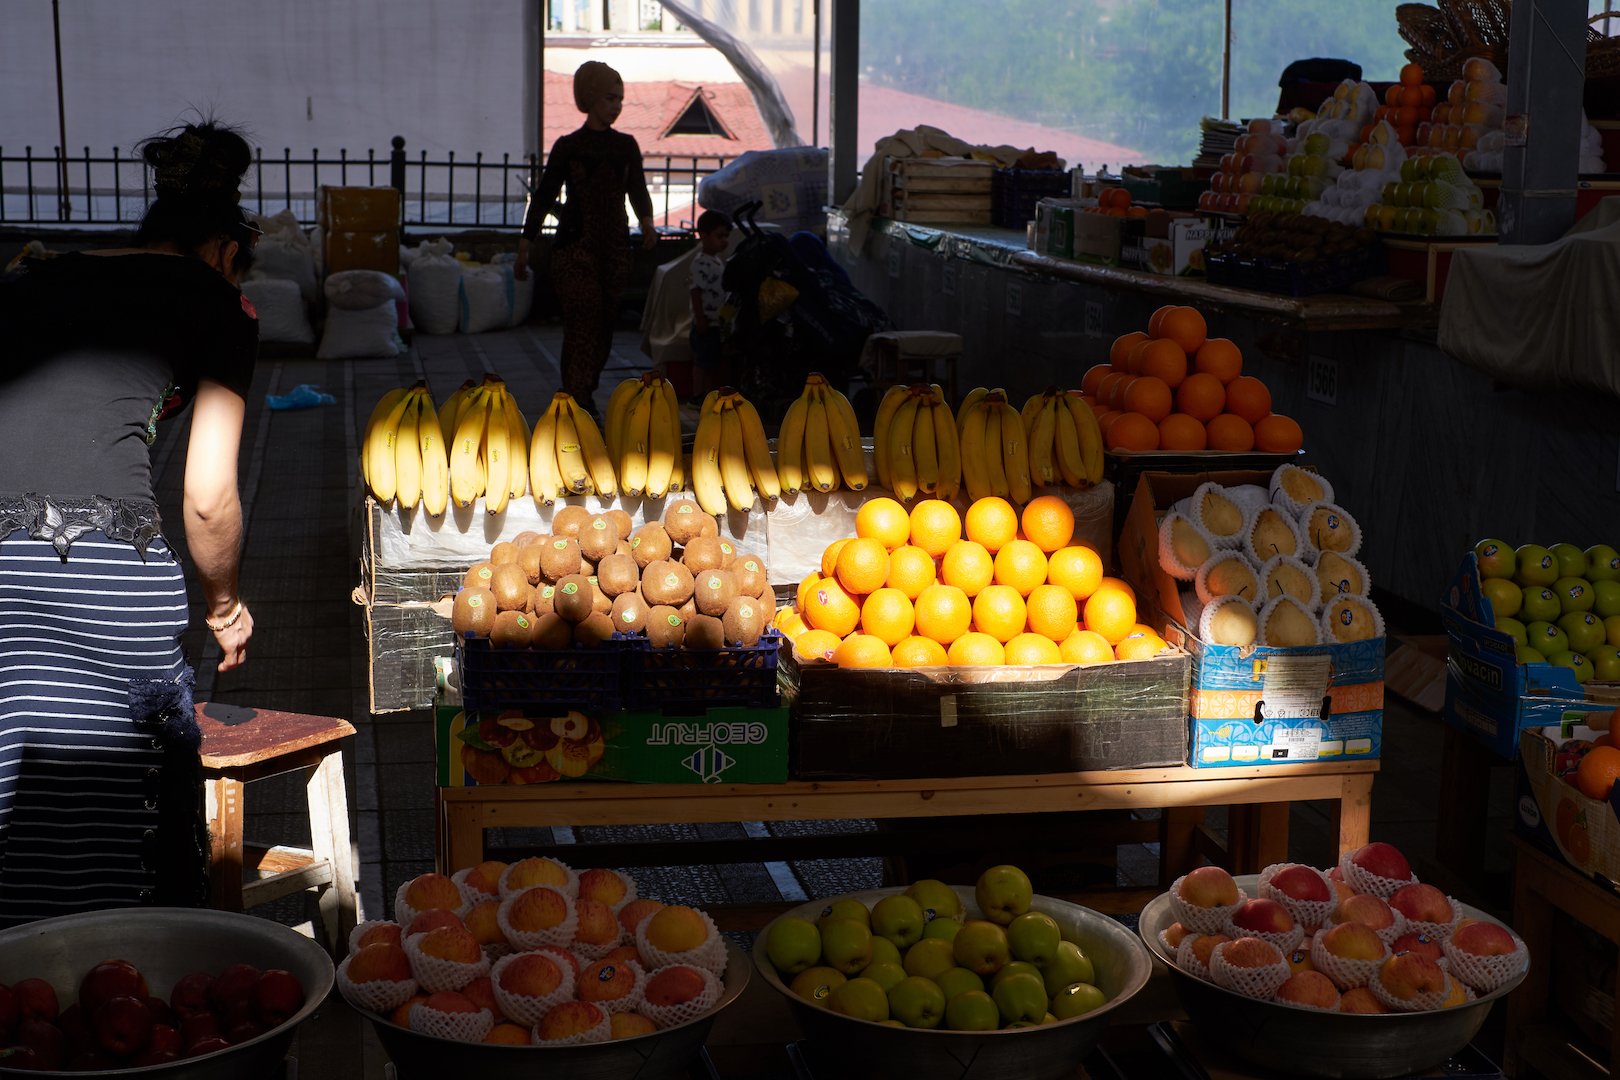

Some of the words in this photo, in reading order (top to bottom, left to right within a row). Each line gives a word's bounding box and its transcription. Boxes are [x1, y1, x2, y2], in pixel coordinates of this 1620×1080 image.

[1186, 229, 1216, 241] HAPPY
[1216, 227, 1238, 240] KIW
[1086, 305, 1101, 332] 1564
[1309, 360, 1336, 398] 1566
[646, 722, 768, 745] GEOFRUT
[1521, 802, 1538, 820] LUXOR
